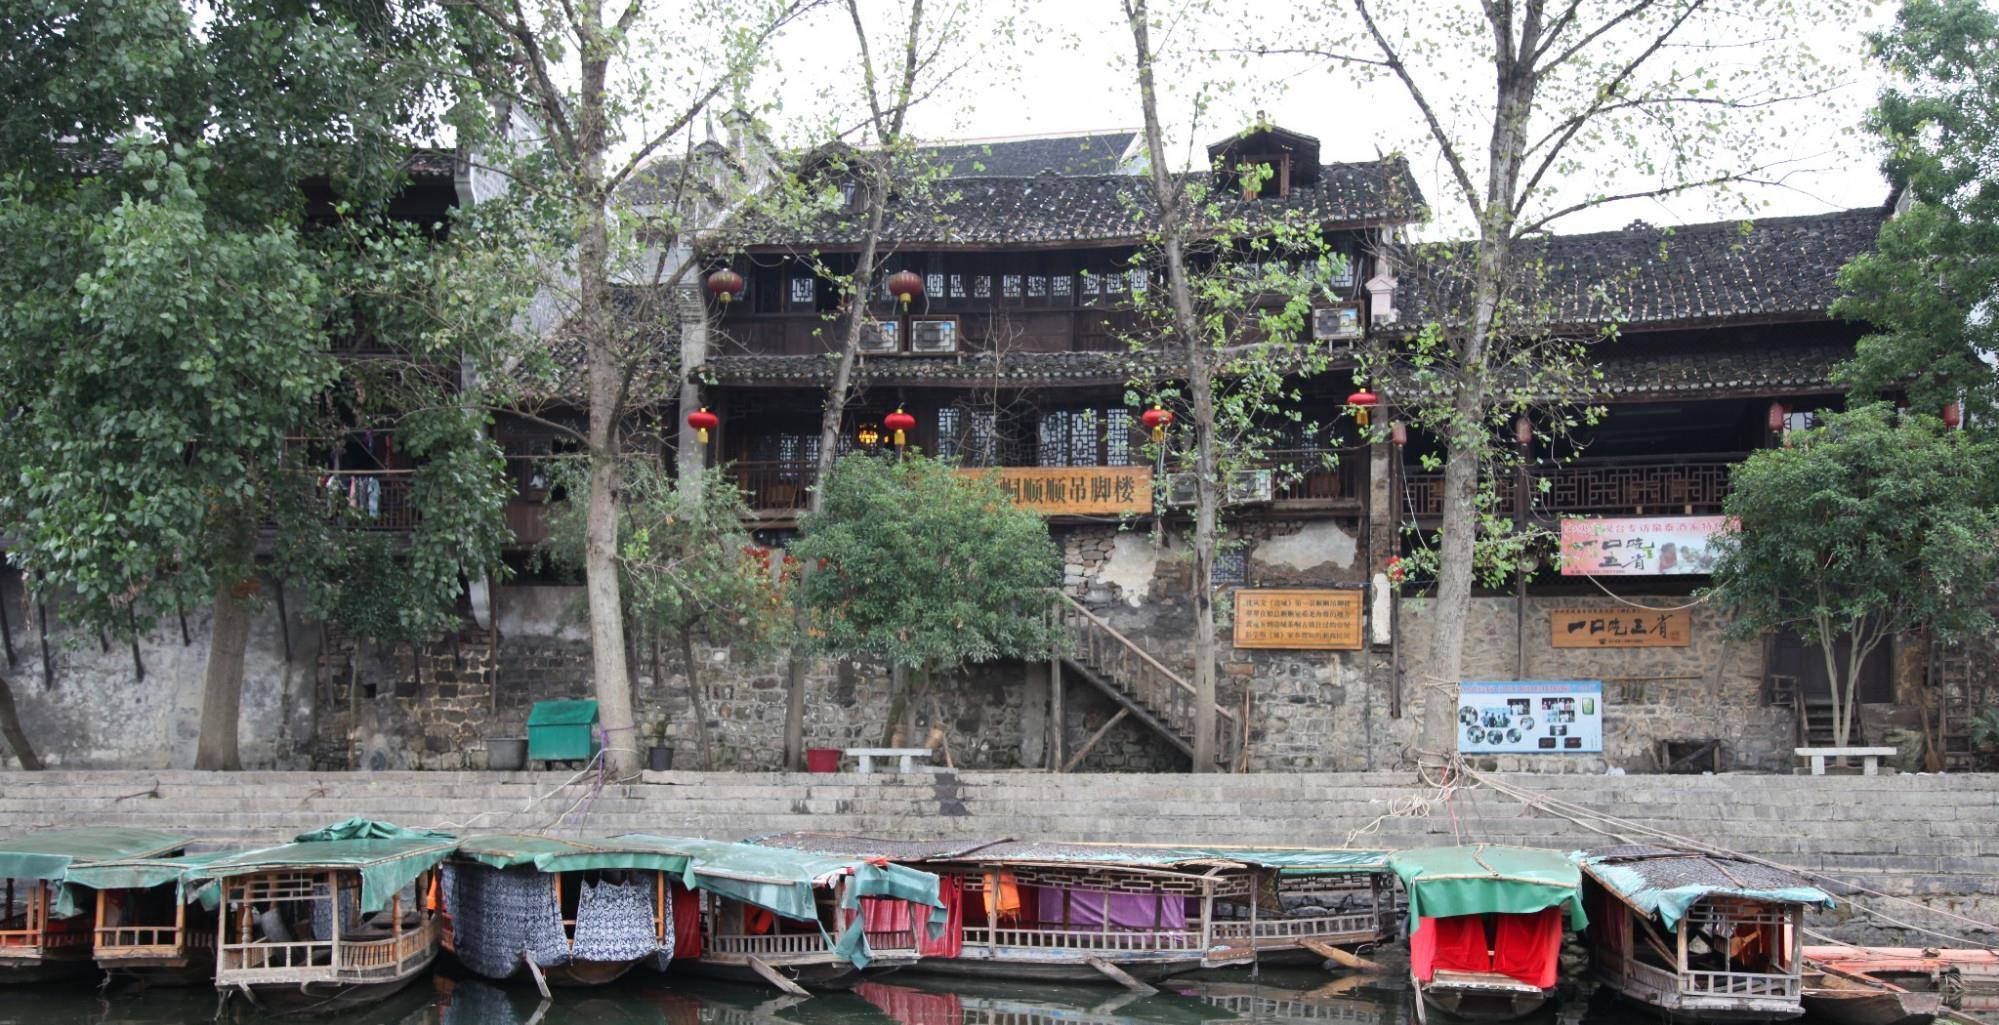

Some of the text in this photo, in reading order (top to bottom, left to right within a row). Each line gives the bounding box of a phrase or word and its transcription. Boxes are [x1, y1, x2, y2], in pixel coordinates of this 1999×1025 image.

[957, 475, 1136, 505] 峒顺顺吊脚楼
